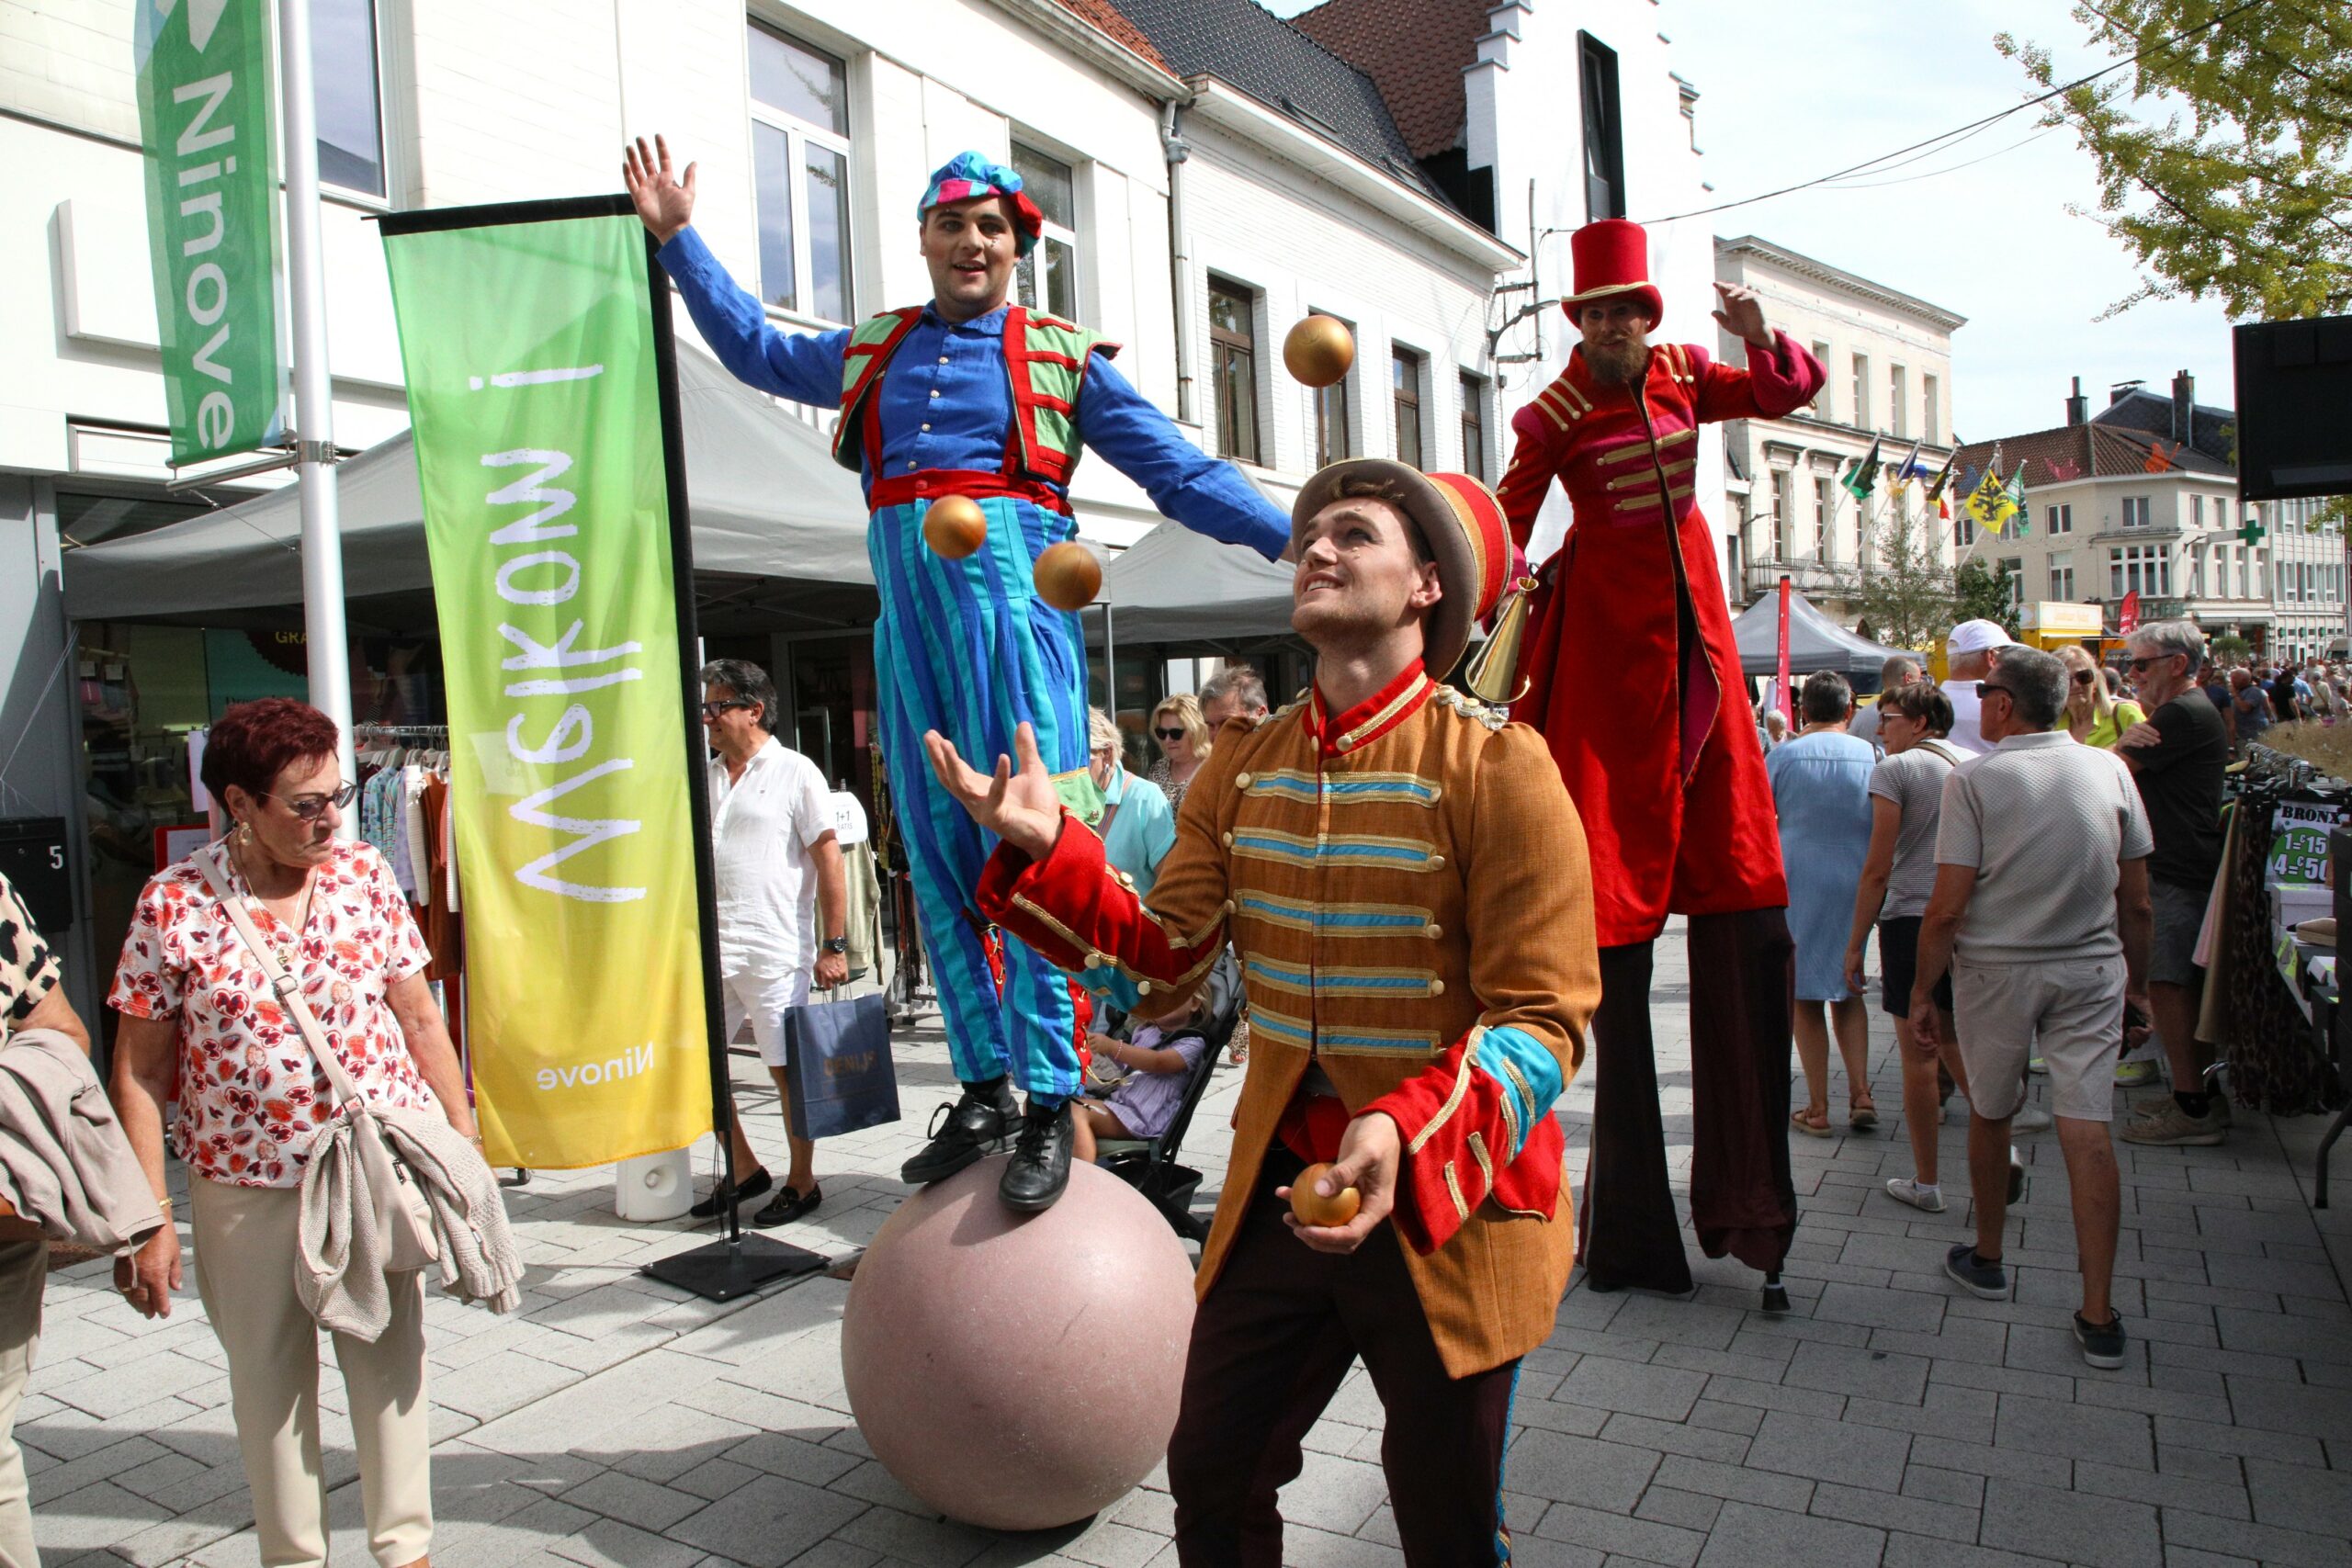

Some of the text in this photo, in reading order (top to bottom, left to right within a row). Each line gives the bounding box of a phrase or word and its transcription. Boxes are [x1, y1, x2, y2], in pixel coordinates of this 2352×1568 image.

[173, 71, 237, 450] Ninove
[276, 631, 308, 644] GRA
[2281, 806, 2340, 824] BRONX
[49, 845, 63, 870] 5
